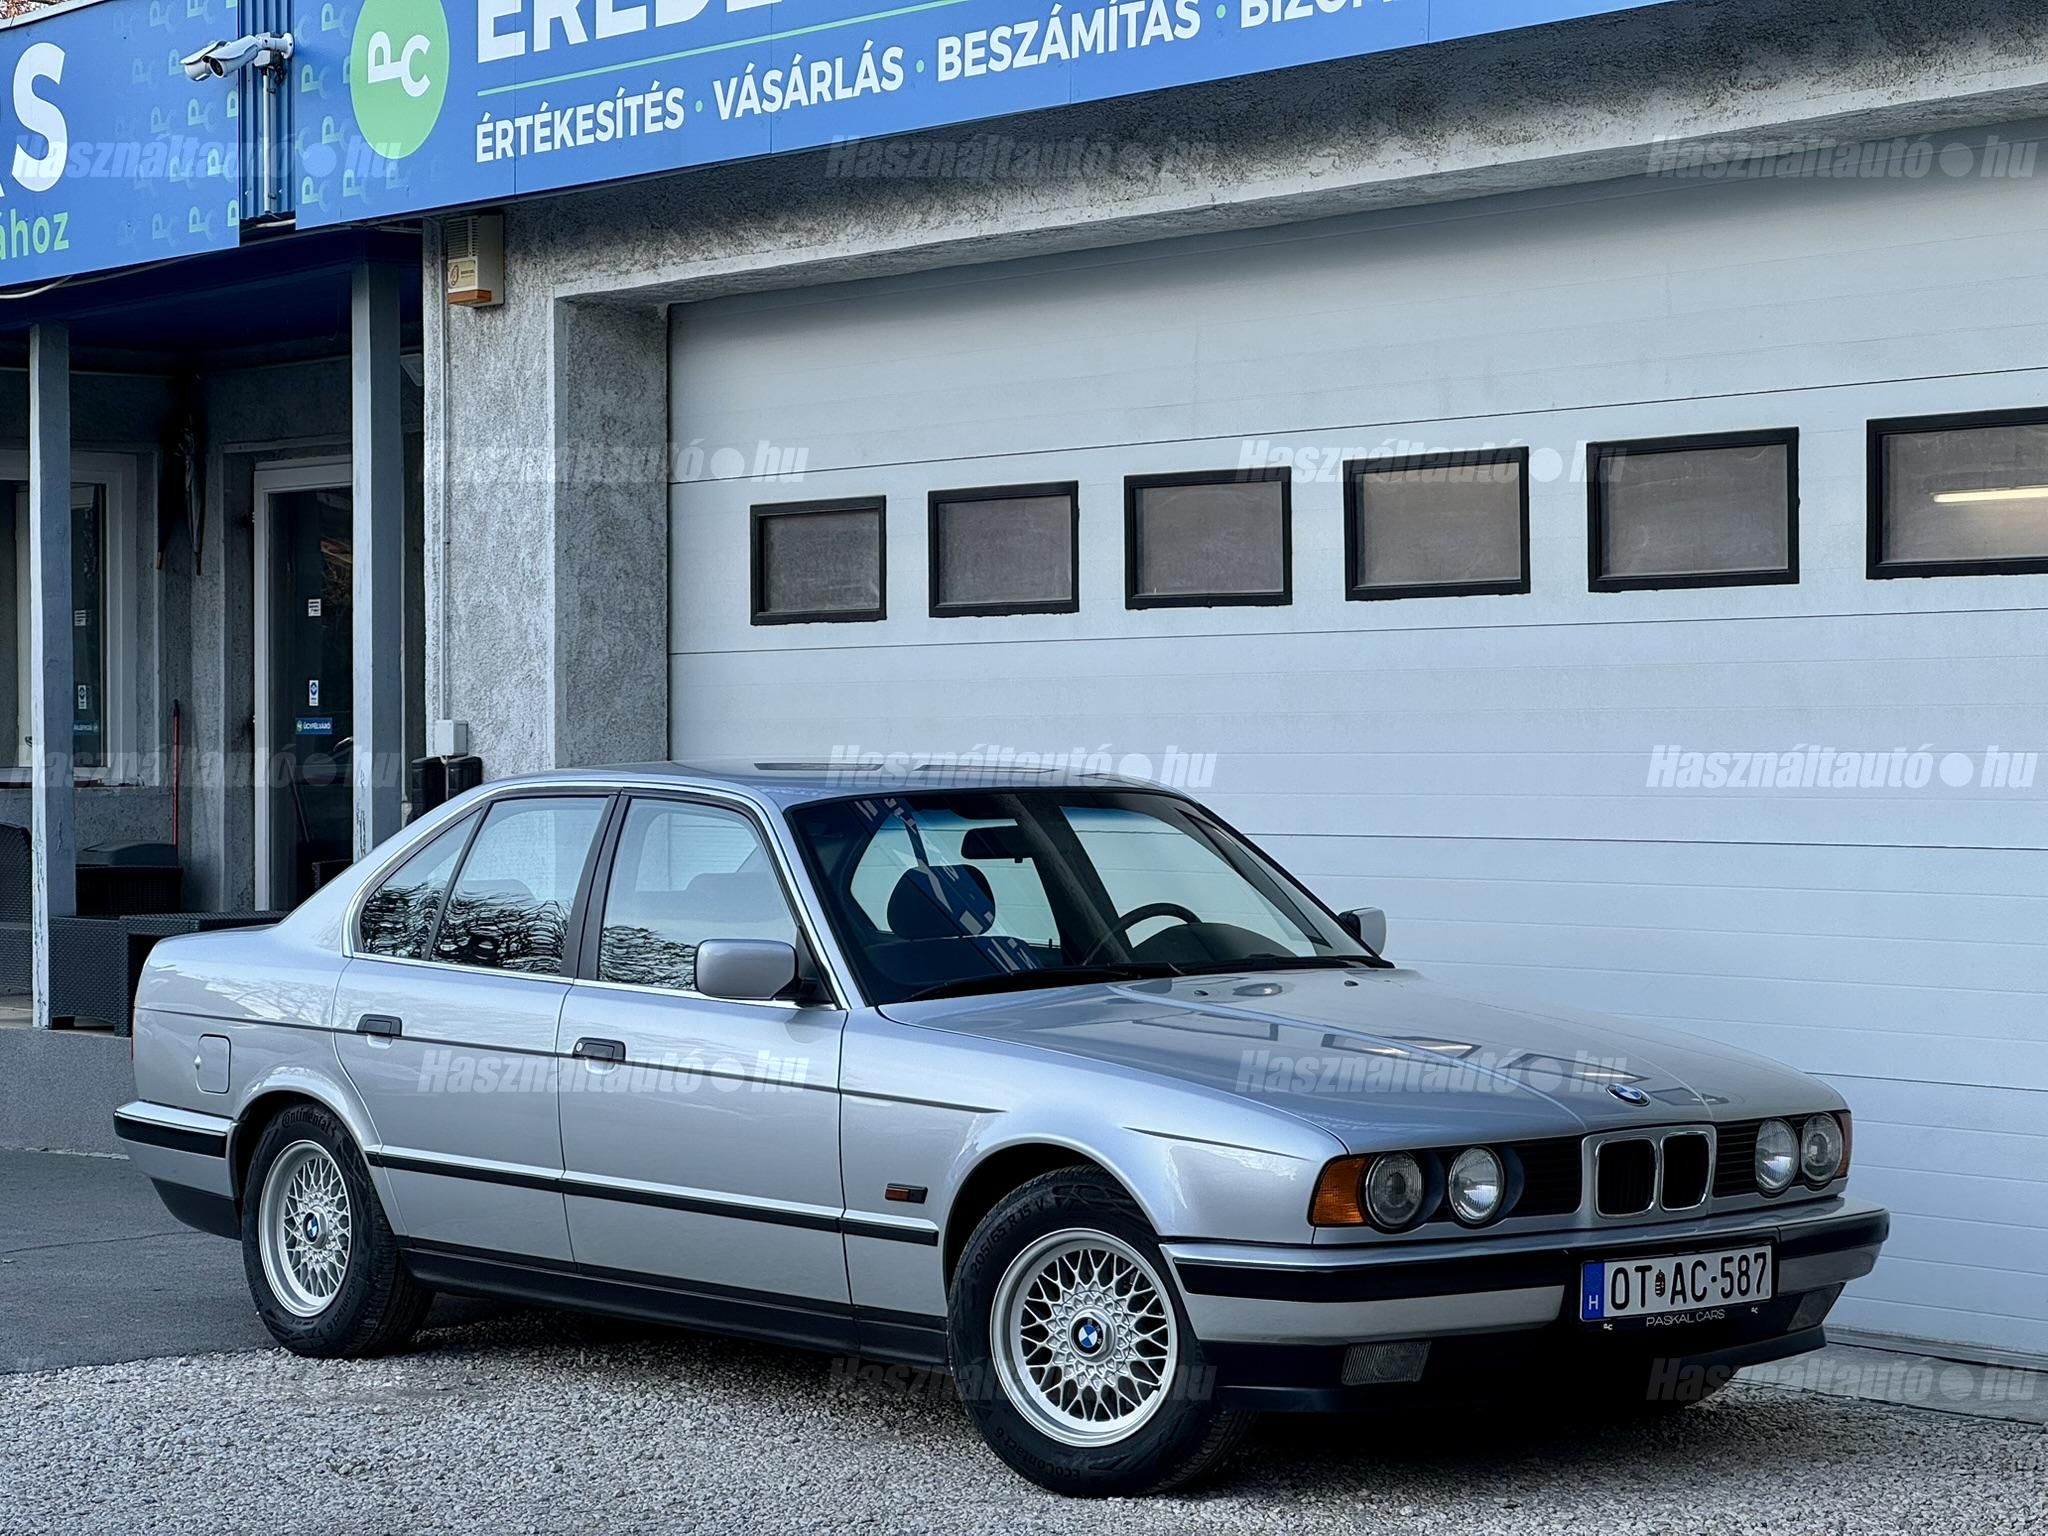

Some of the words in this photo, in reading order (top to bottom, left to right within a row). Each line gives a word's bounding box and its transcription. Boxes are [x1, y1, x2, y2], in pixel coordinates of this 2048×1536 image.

[476, 80, 684, 162] ÉRTÉKESÍTÉS
[712, 39, 904, 120] VÁSÁRLÁS
[1588, 1294, 1599, 1310] H
[1610, 1264, 1653, 1310] OT
[1646, 1311, 1695, 1328] PASKAL
[1696, 1309, 1726, 1323] CARS
